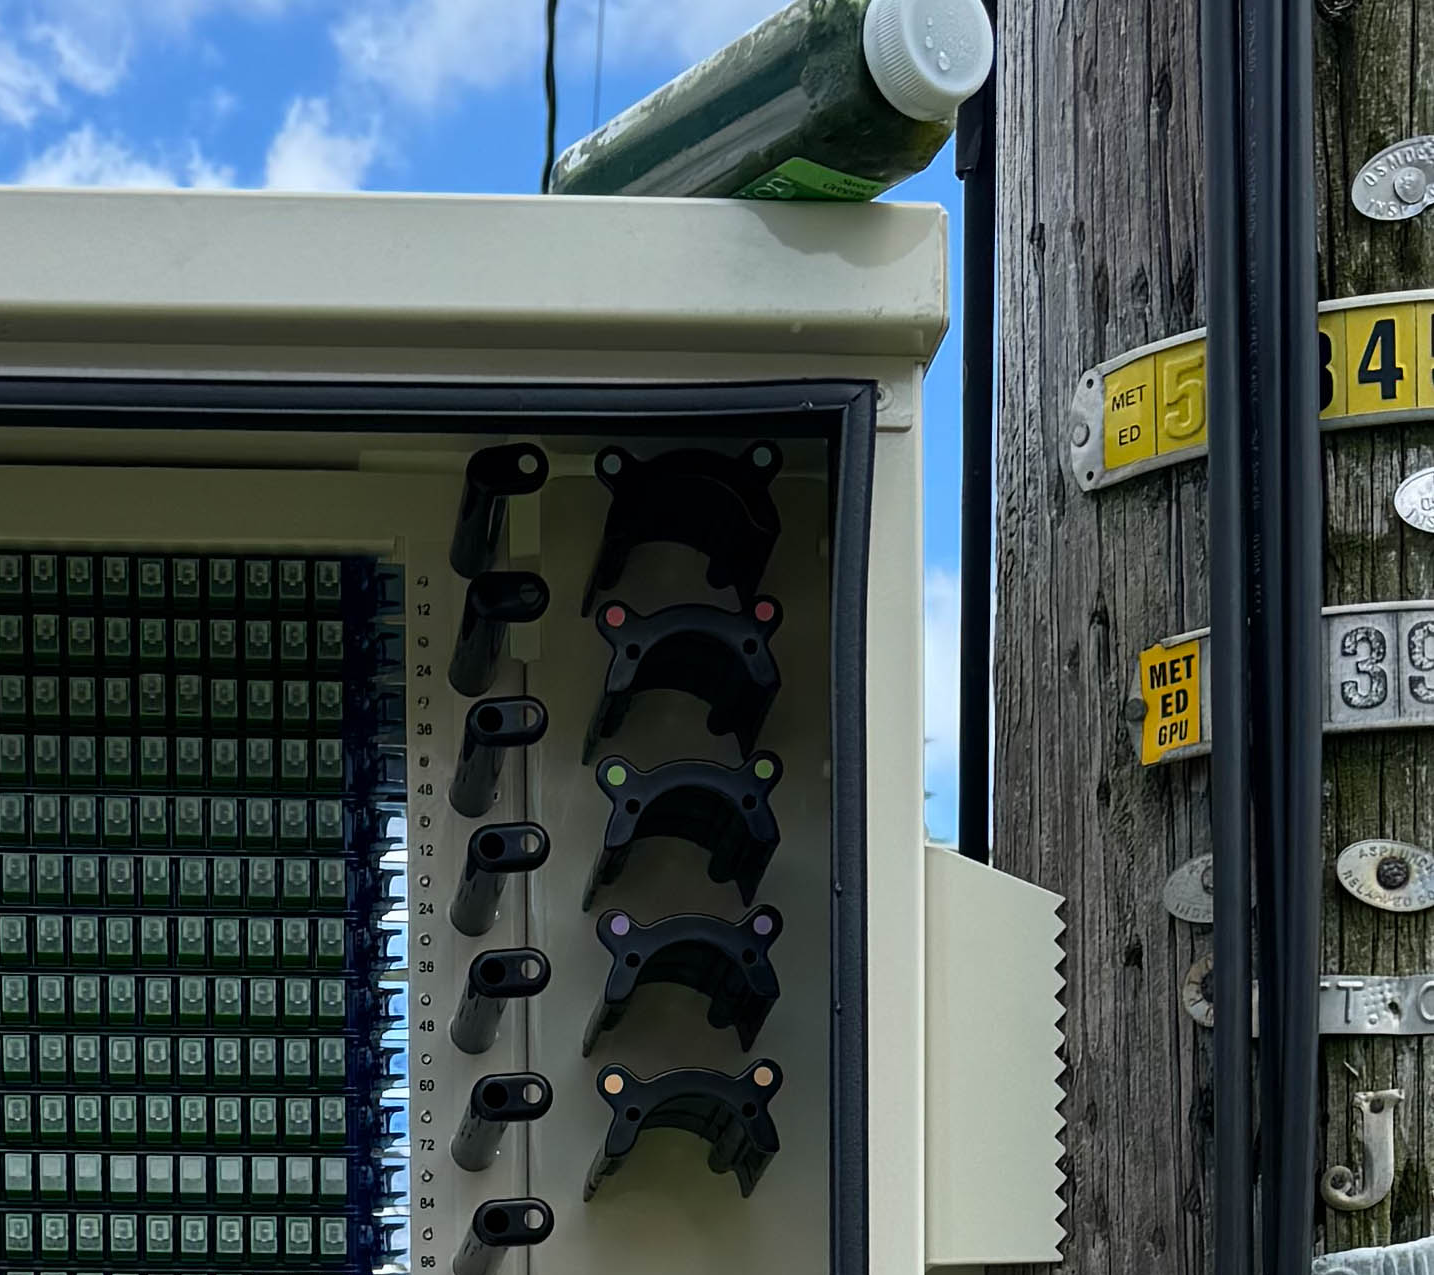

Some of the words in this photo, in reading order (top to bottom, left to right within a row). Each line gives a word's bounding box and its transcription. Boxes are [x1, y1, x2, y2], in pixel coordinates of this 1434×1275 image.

[1111, 384, 1147, 412] MET
[1118, 425, 1141, 446] ED
[416, 603, 431, 616] 12
[416, 664, 432, 677] 24
[1149, 653, 1195, 689] MET
[1160, 688, 1189, 719] ED
[1158, 720, 1188, 749] GPU
[417, 783, 433, 796] 48
[419, 844, 434, 857] 12
[418, 902, 434, 915] 24
[418, 1019, 435, 1032] 48
[419, 1079, 435, 1092] 60
[419, 1138, 435, 1151] 72
[1320, 1088, 1405, 1211] J
